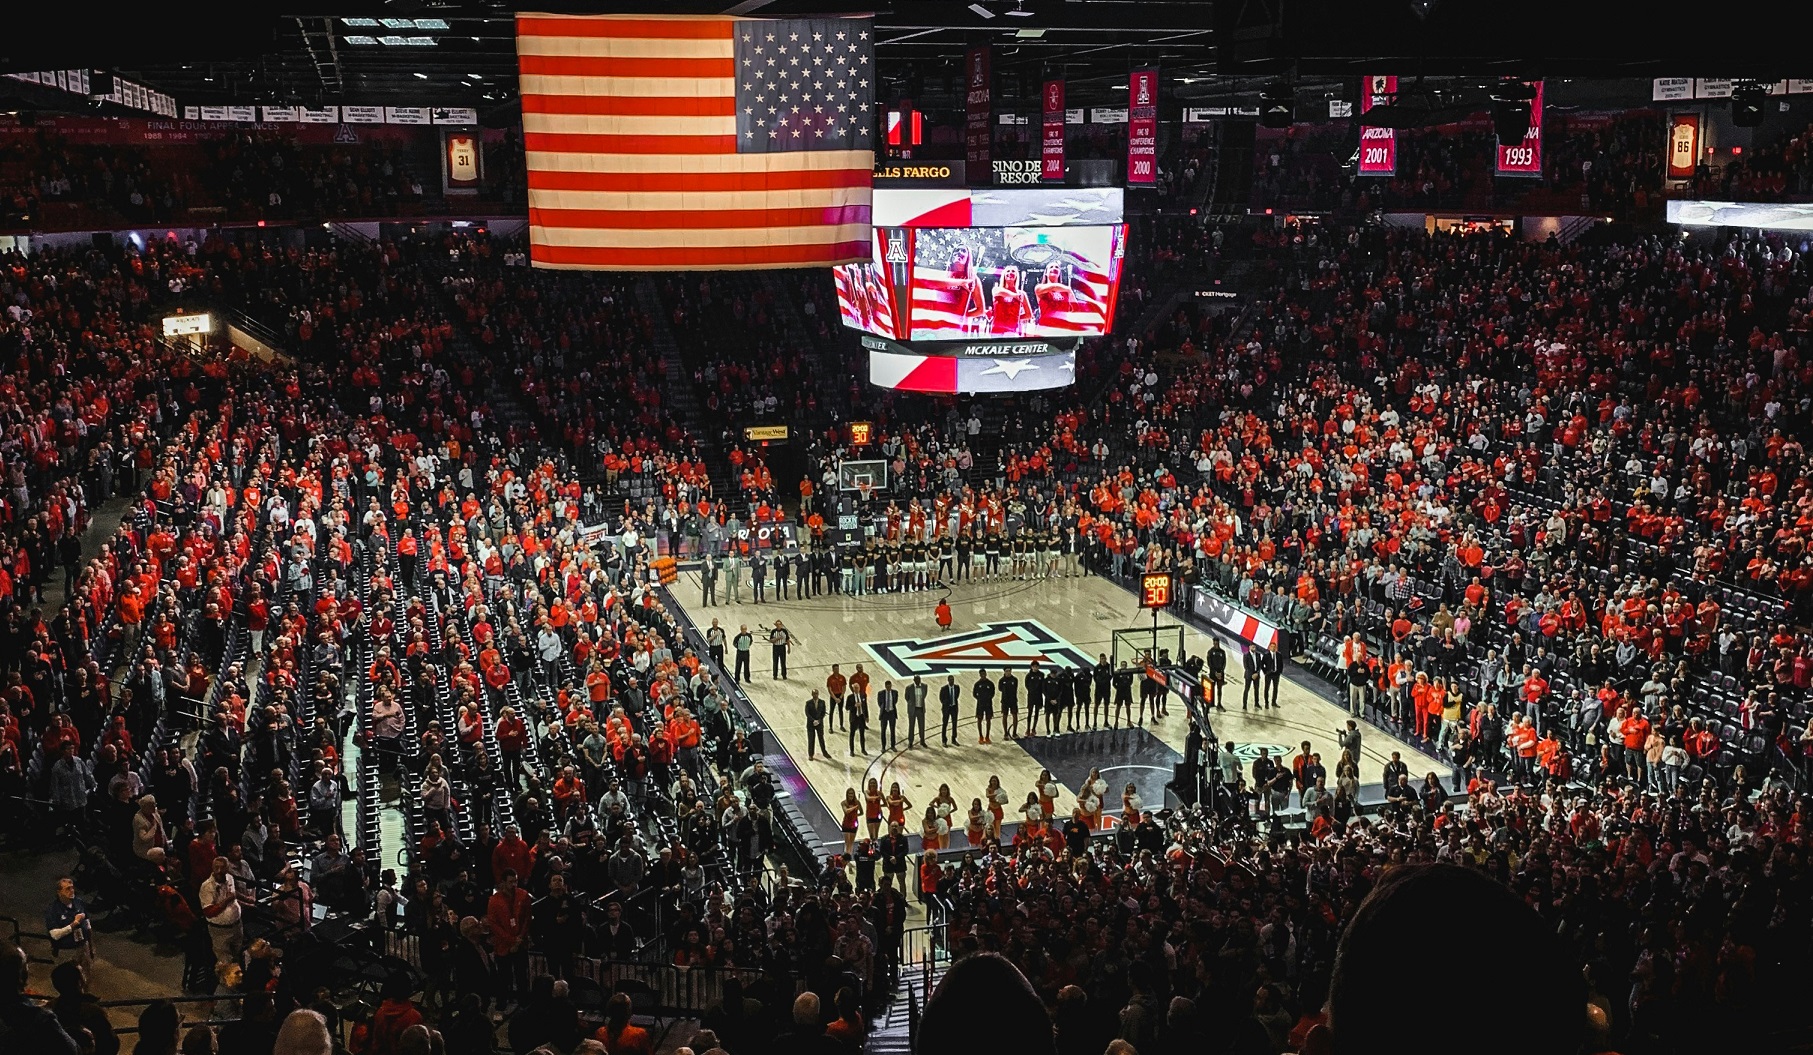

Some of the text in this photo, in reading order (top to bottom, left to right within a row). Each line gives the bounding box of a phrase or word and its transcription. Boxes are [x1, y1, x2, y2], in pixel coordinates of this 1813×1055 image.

[147, 121, 176, 130] FINAL
[179, 121, 206, 130] FOUR
[1362, 127, 1393, 139] ARIZONA
[1677, 141, 1689, 153] 86
[458, 155, 469, 166] 31
[1365, 148, 1388, 163] 2001
[1505, 147, 1532, 165] 1993
[993, 160, 1023, 172] SINO
[1046, 159, 1060, 171] 2004
[1133, 161, 1150, 174] 2000
[903, 166, 951, 178] FARGO
[965, 343, 1049, 355] MCKALE CENTER
[854, 432, 867, 443] 30
[1144, 576, 1168, 588] 20:00
[1147, 588, 1166, 604] 30
